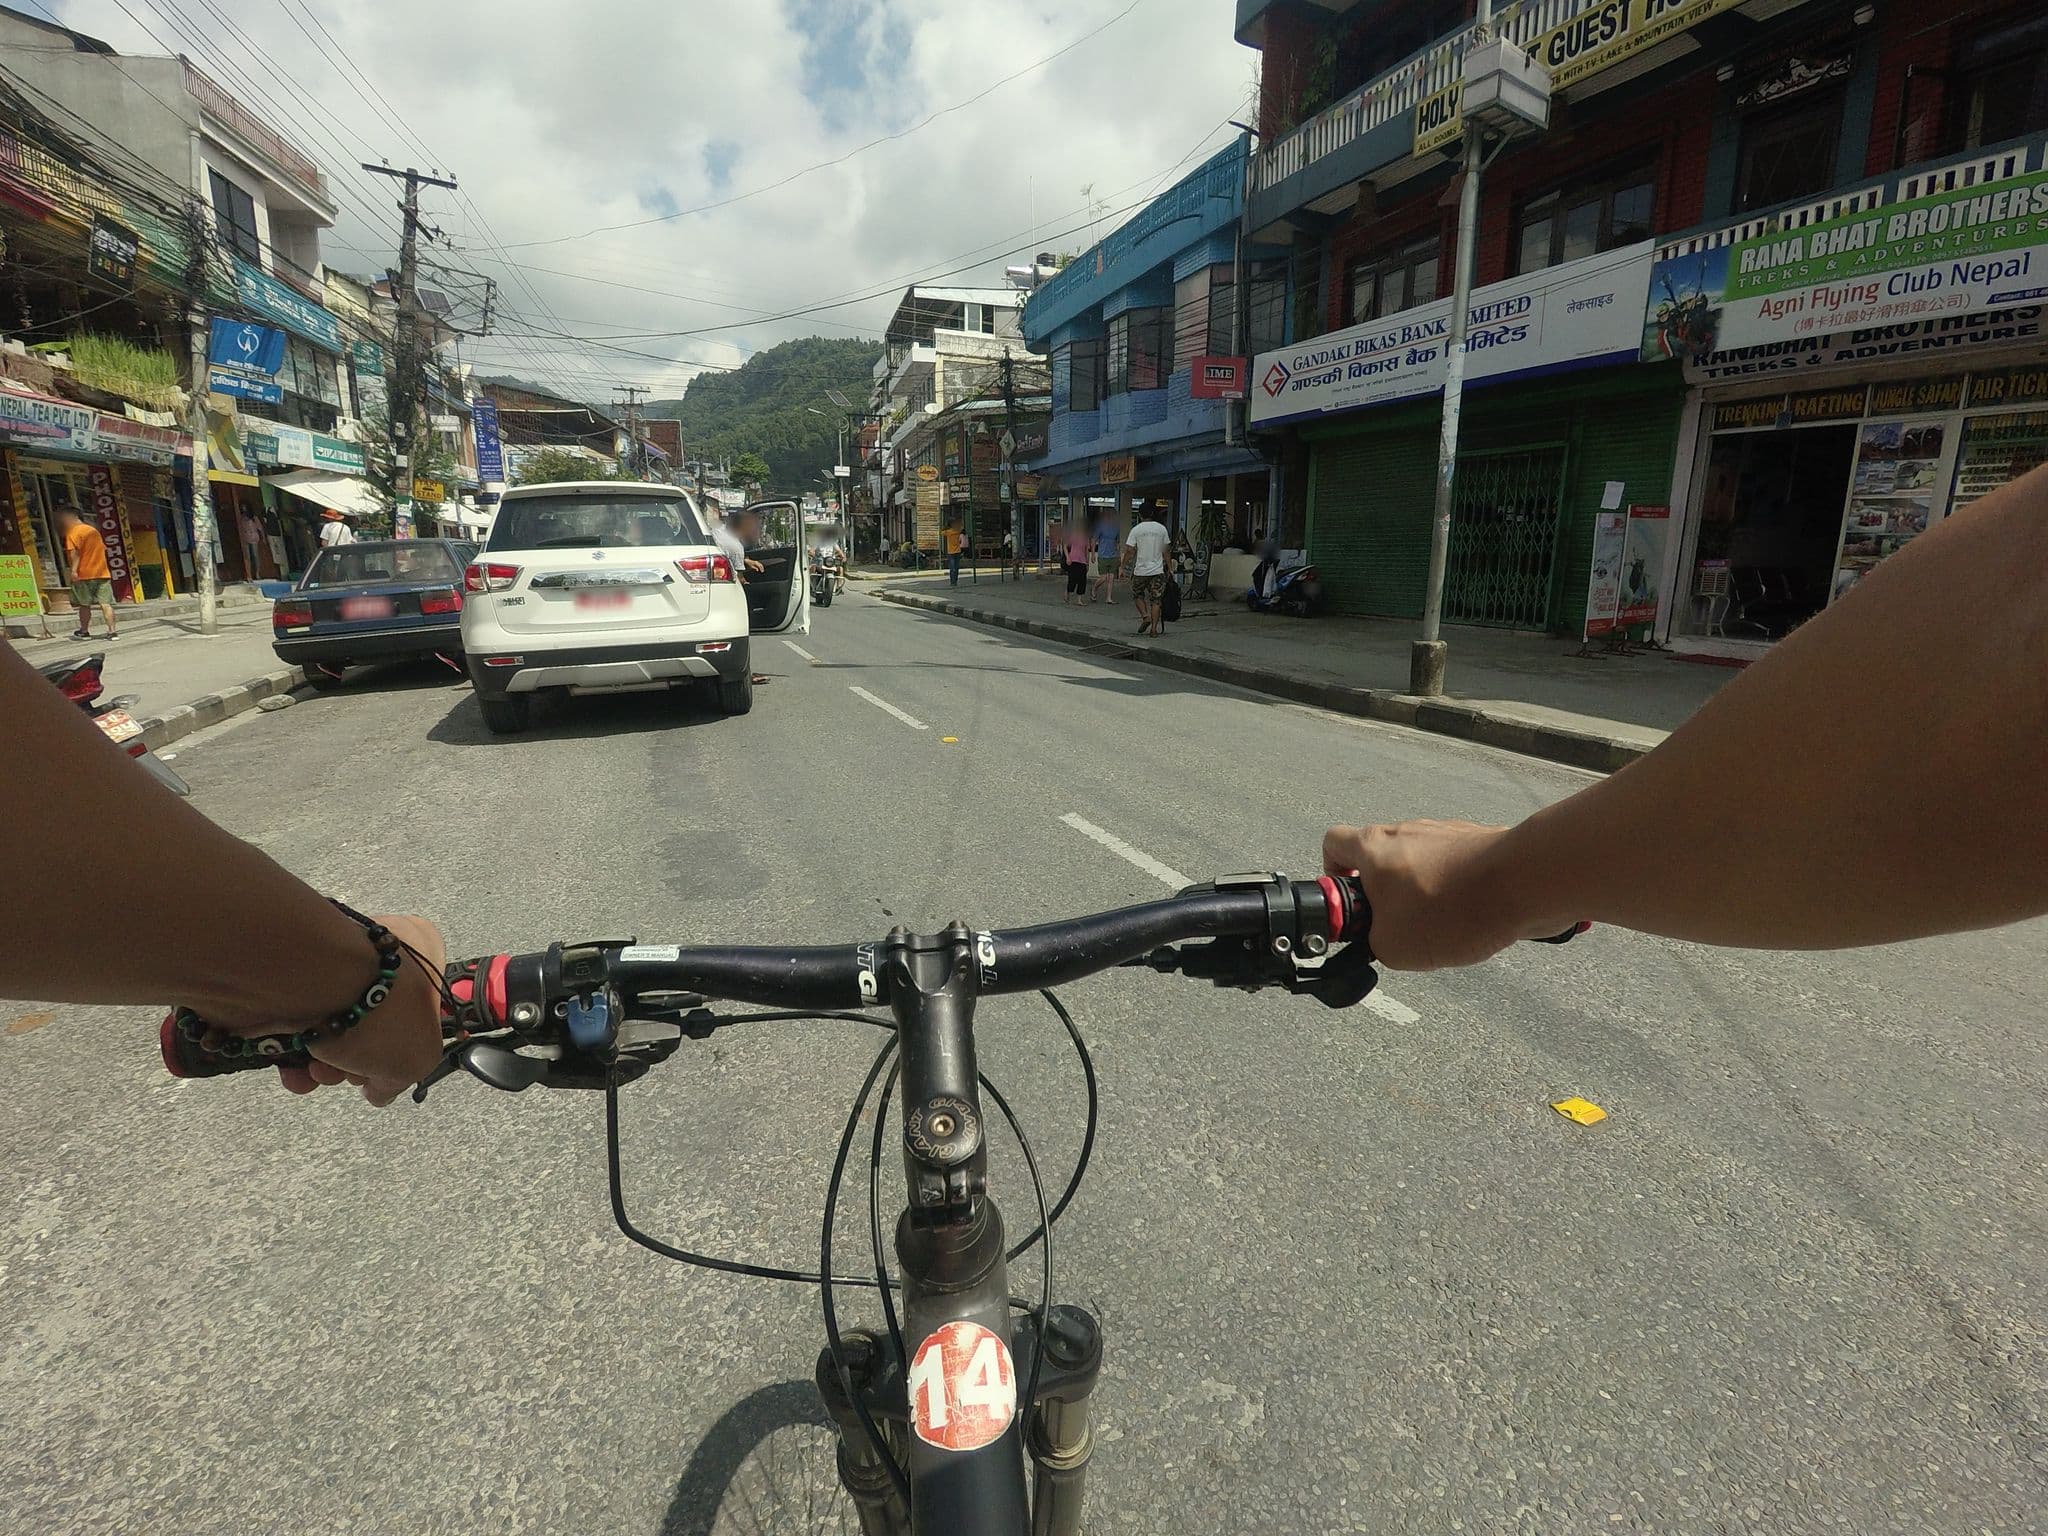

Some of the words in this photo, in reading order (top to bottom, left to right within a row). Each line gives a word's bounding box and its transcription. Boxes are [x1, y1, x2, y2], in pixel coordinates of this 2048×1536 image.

[1418, 85, 1459, 135] HOLY
[1548, 0, 1630, 66] GUEST
[1418, 139, 1431, 152] ALL
[1434, 127, 1457, 144] ROOMS
[1634, 17, 1685, 46] MOUNTAIN
[1738, 264, 1809, 288] TREKS
[1826, 259, 1837, 270] &
[1853, 217, 2048, 265] ADVENTURES
[1739, 237, 1802, 274] RANA
[1809, 218, 1882, 258] BHAT
[1886, 182, 2048, 243] BROTHERS
[1757, 291, 1805, 320] Agni
[1811, 282, 1880, 311] Flying
[1888, 268, 1942, 296] Club
[1950, 252, 2031, 286] Nepal
[1293, 344, 1350, 371] GANDAKI
[1354, 332, 1397, 356] BIKAS
[1400, 318, 1447, 345] BANK
[1466, 295, 1532, 326] MITED
[1702, 358, 1797, 379] TREKS
[1806, 354, 1822, 365] &
[1835, 323, 2040, 361] ADVENTURE
[1210, 368, 1232, 379] IME
[1292, 368, 1343, 392] गण्डकी
[1347, 355, 1400, 380] विकास
[1406, 346, 1439, 366] बैंक
[1972, 376, 2005, 400] AIR
[0, 398, 29, 420] NEPAL
[32, 402, 50, 425] TEA
[73, 410, 90, 430] LTD
[1717, 400, 1784, 423] TREKKING
[1794, 391, 1864, 416] RAFTING
[92, 472, 117, 530] PHOTO
[104, 534, 127, 581] SHOP
[2, 601, 37, 610] SHOP
[4, 590, 30, 598] TEA
[909, 1336, 1010, 1430] 14
